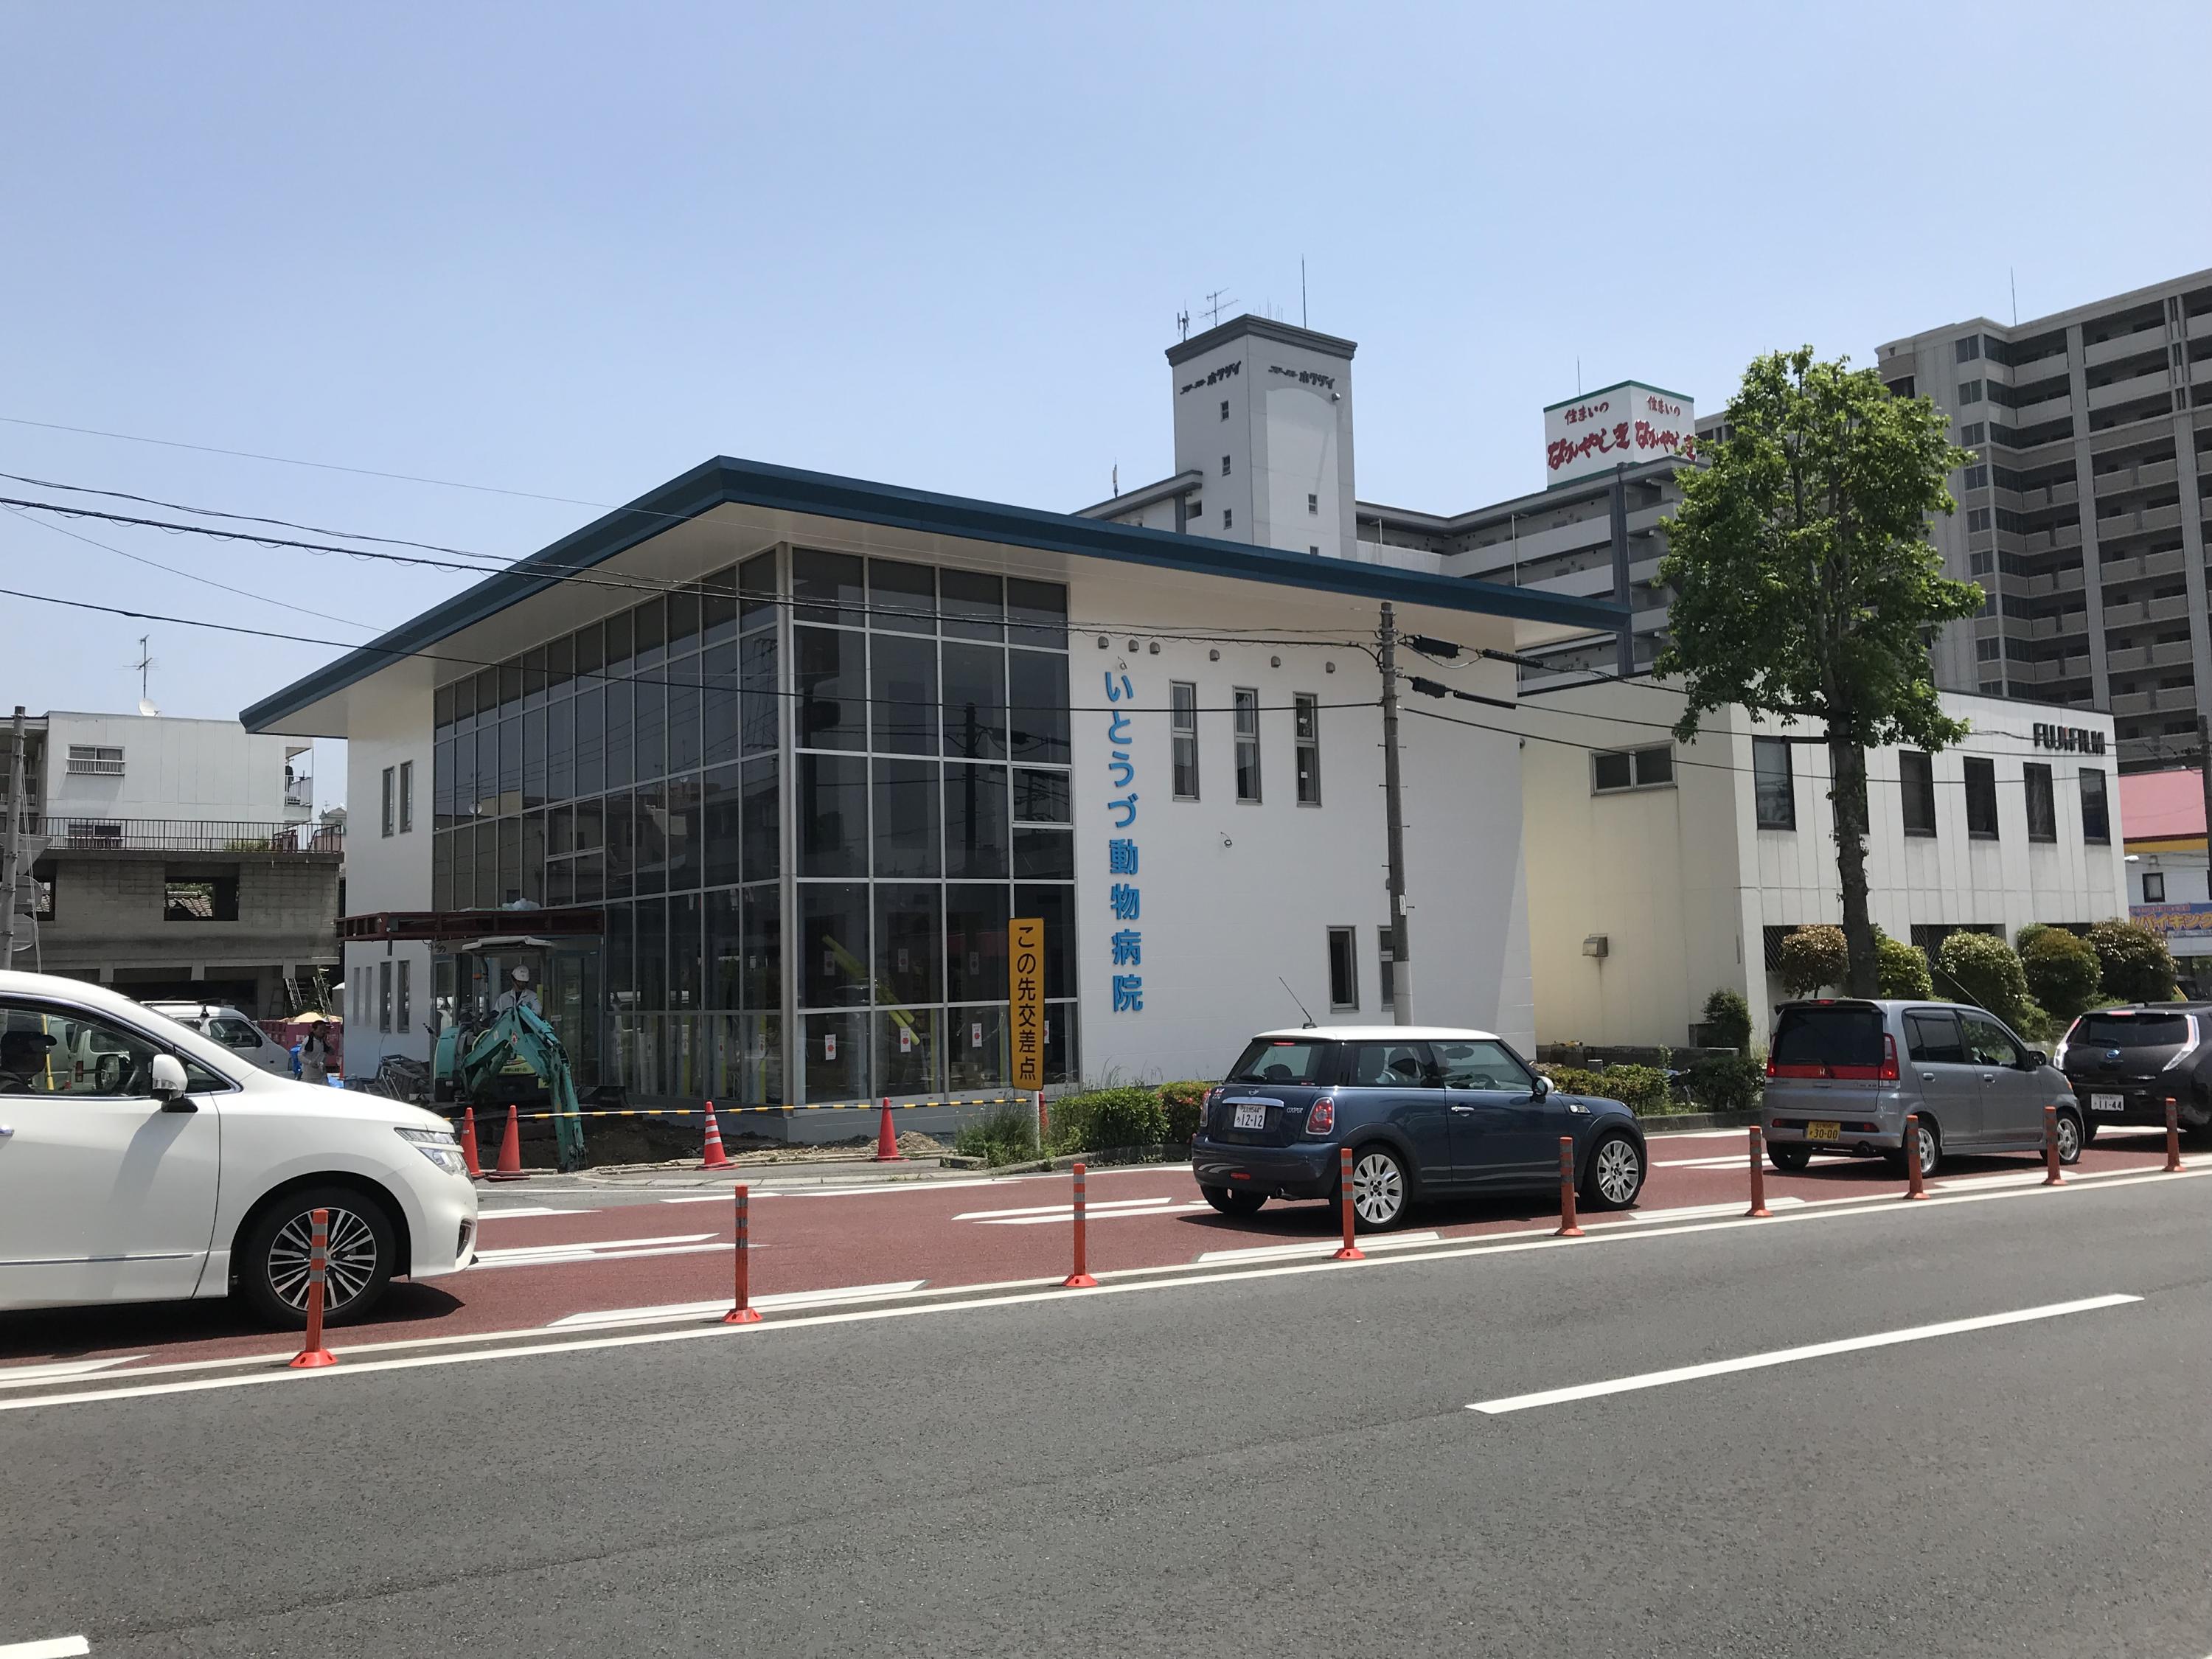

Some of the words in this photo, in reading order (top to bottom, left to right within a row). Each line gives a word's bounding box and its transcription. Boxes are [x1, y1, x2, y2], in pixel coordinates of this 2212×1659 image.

[1565, 402, 1610, 425] 住まいの
[1647, 395, 1681, 417] 住まいの
[1548, 422, 1630, 470] なかやしき
[2033, 722, 2107, 756] FUJIFILM
[1105, 671, 1144, 1012] いとうづ動物病院
[1017, 926, 1037, 1081] この先交差点
[1242, 1113, 1263, 1127] 12-12
[1814, 1128, 1838, 1139] 30-00
